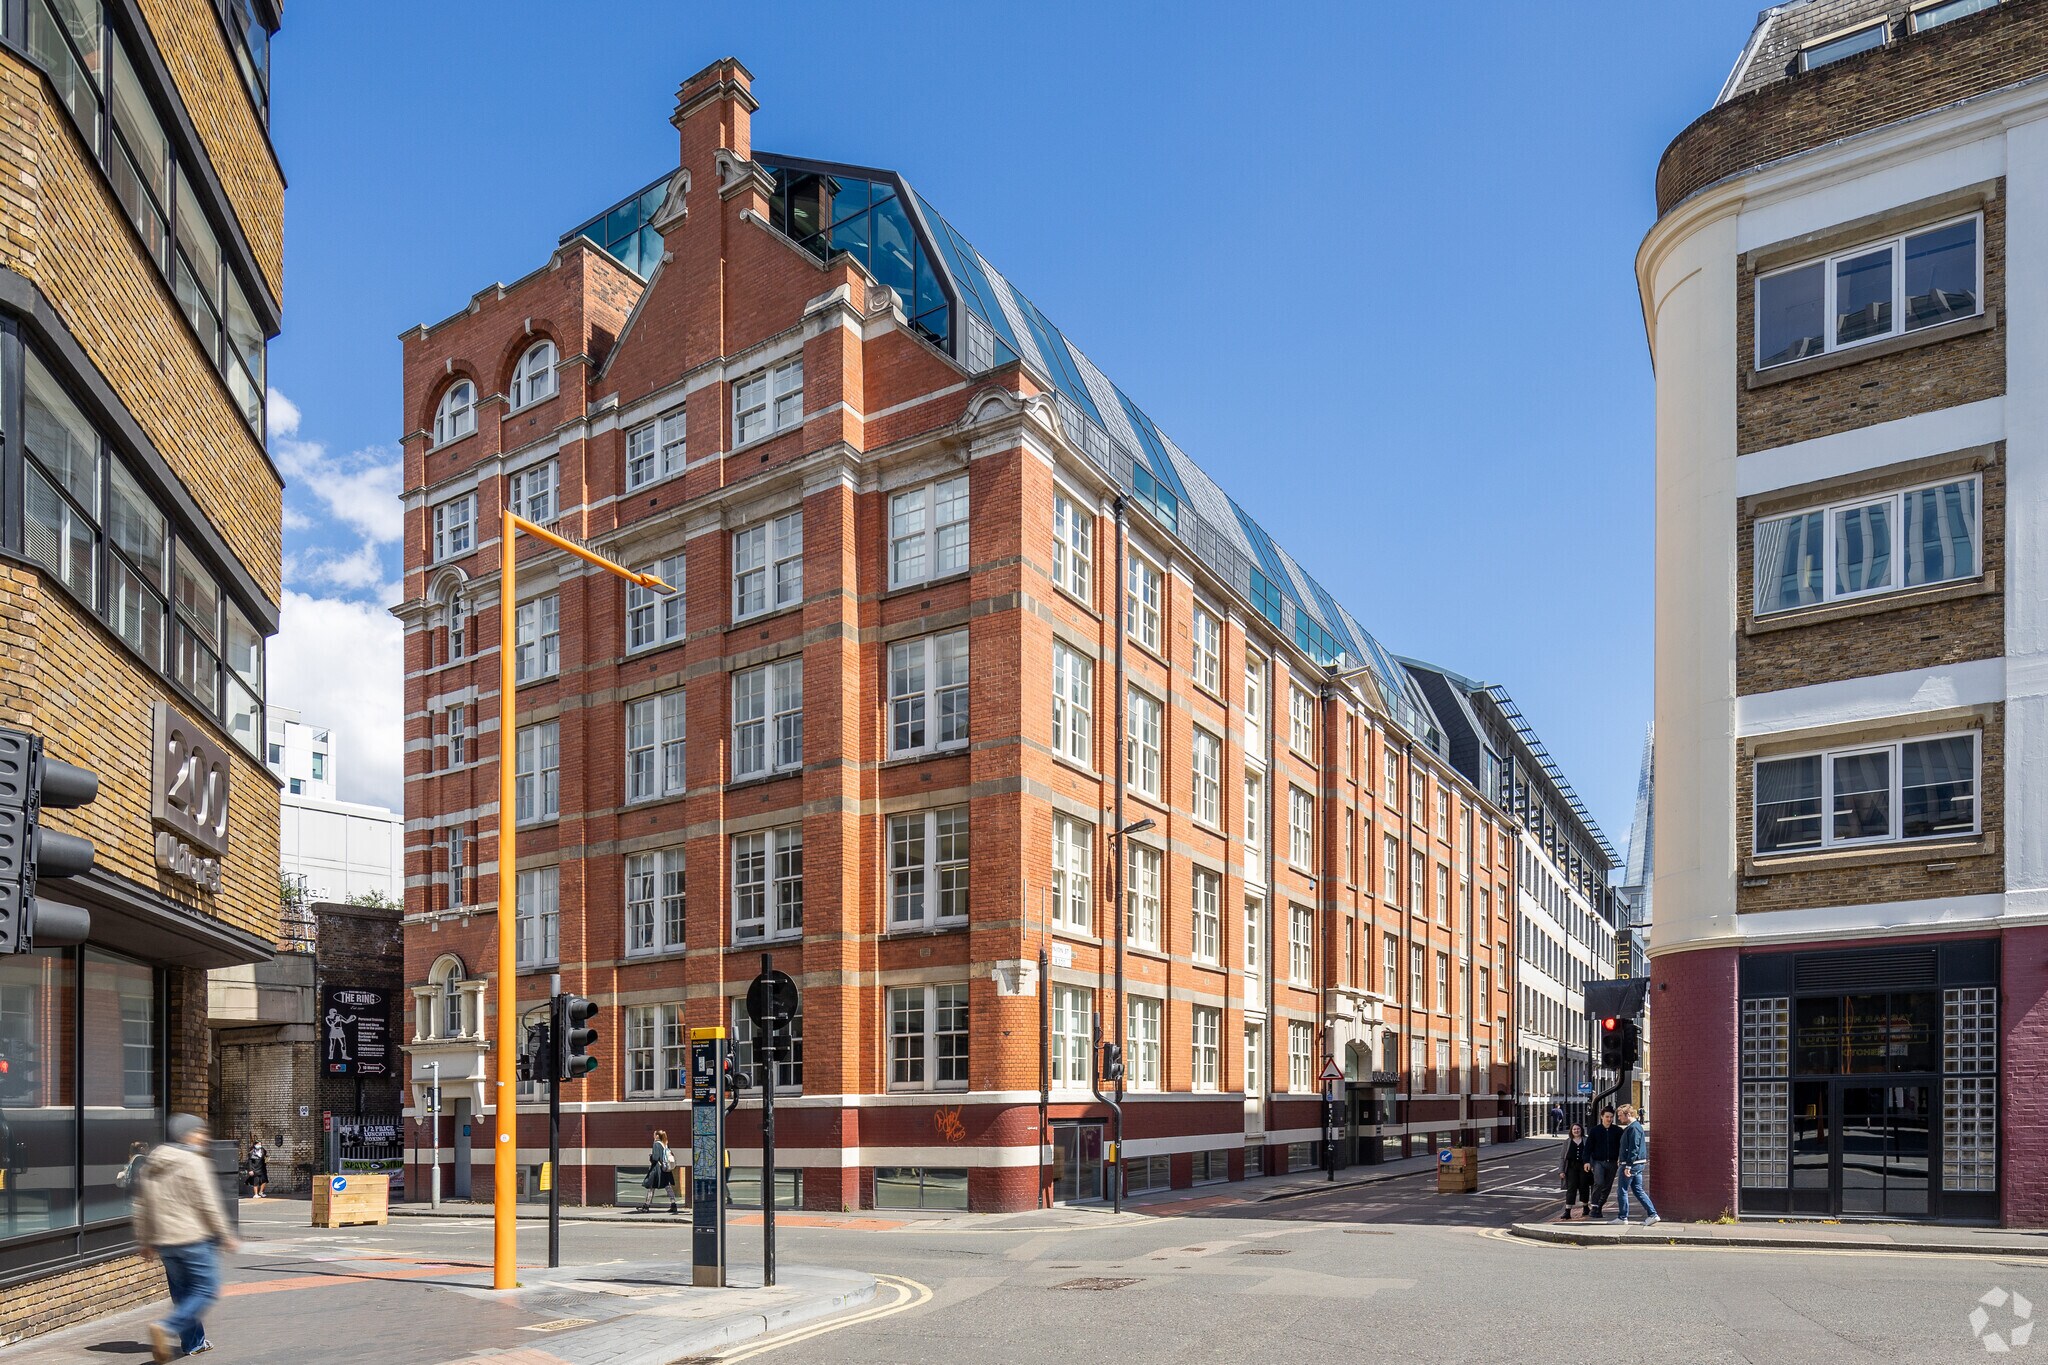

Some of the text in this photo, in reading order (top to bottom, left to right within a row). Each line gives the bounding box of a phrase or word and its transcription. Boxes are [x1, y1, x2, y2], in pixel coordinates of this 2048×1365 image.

[168, 728, 226, 838] 200
[156, 831, 206, 884] Union
[1617, 941, 1630, 964] THE
[340, 991, 375, 1005] THE RING
[363, 1125, 375, 1133] 1/2
[344, 1161, 369, 1169] SPOTS
